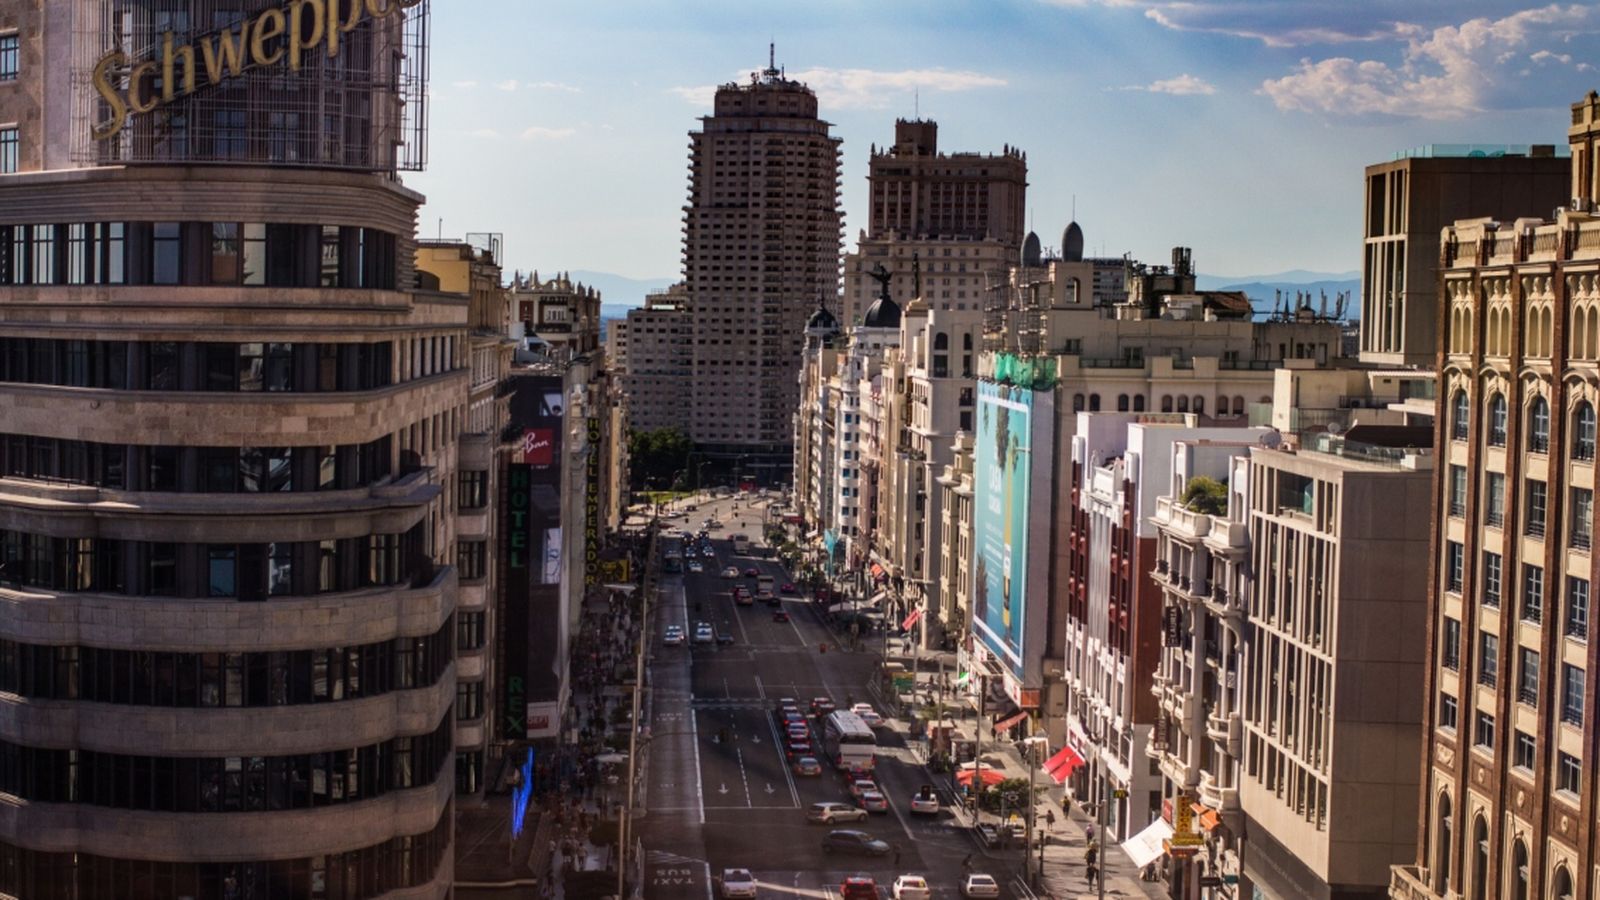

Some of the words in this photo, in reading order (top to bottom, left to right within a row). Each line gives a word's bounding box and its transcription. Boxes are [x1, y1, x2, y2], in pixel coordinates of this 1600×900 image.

[91, 0, 421, 140] Schwepp
[511, 471, 527, 568] HOTEL
[507, 676, 524, 734] REX
